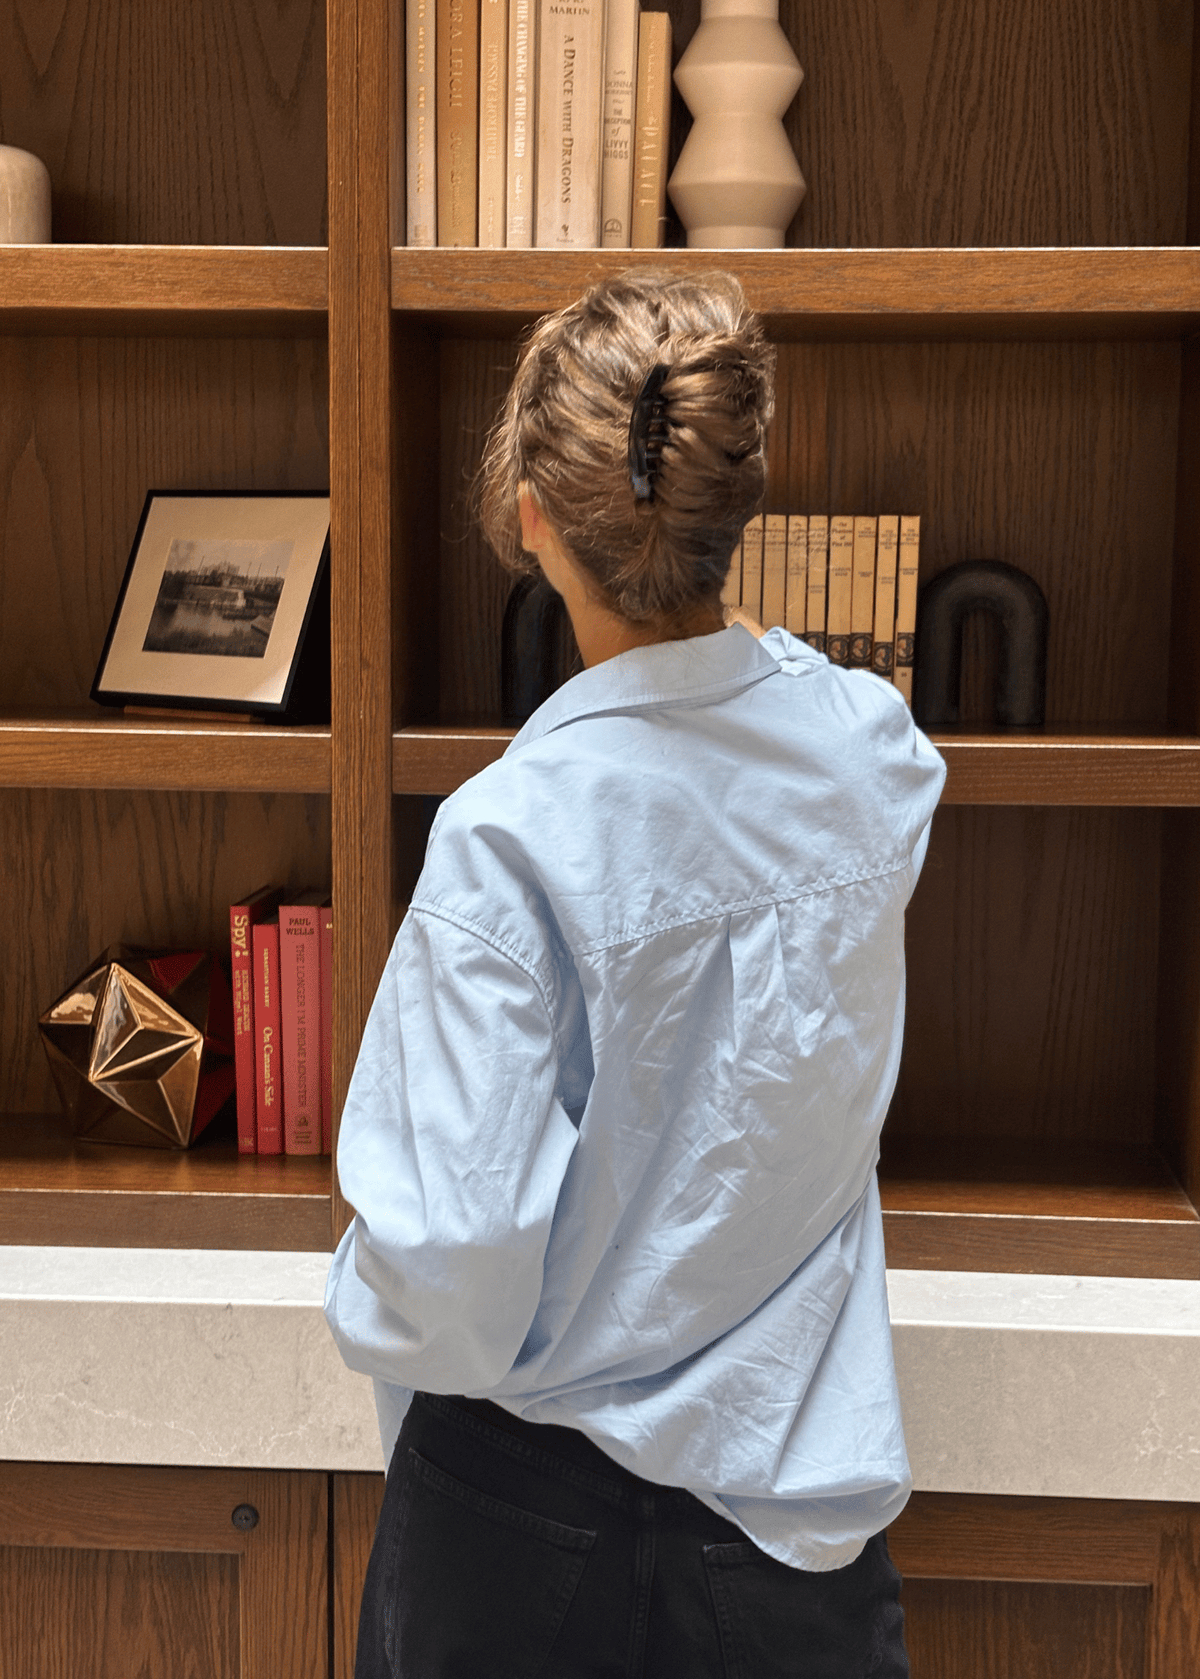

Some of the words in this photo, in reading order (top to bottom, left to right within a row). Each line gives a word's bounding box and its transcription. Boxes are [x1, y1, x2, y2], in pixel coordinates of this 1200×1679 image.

[549, 5, 590, 15] MARTIN
[563, 34, 574, 44] A
[515, 24, 528, 78] CHANGING
[562, 48, 576, 96] DANCE
[515, 79, 527, 93] OF
[514, 96, 526, 119] THE
[514, 120, 526, 158] GUARD
[605, 139, 629, 149] LIVVY
[561, 137, 574, 204] DRAGONS
[286, 927, 315, 936] WELLS
[289, 917, 311, 927] PAUL
[233, 914, 250, 958] Spy!
[296, 943, 305, 964] THE
[296, 965, 306, 1007] LONGER
[263, 1026, 273, 1043] On
[297, 1026, 307, 1059] PRIME
[263, 1044, 274, 1085] Canaan's
[297, 1060, 307, 1108] MINISTER
[263, 1085, 274, 1107] Side
